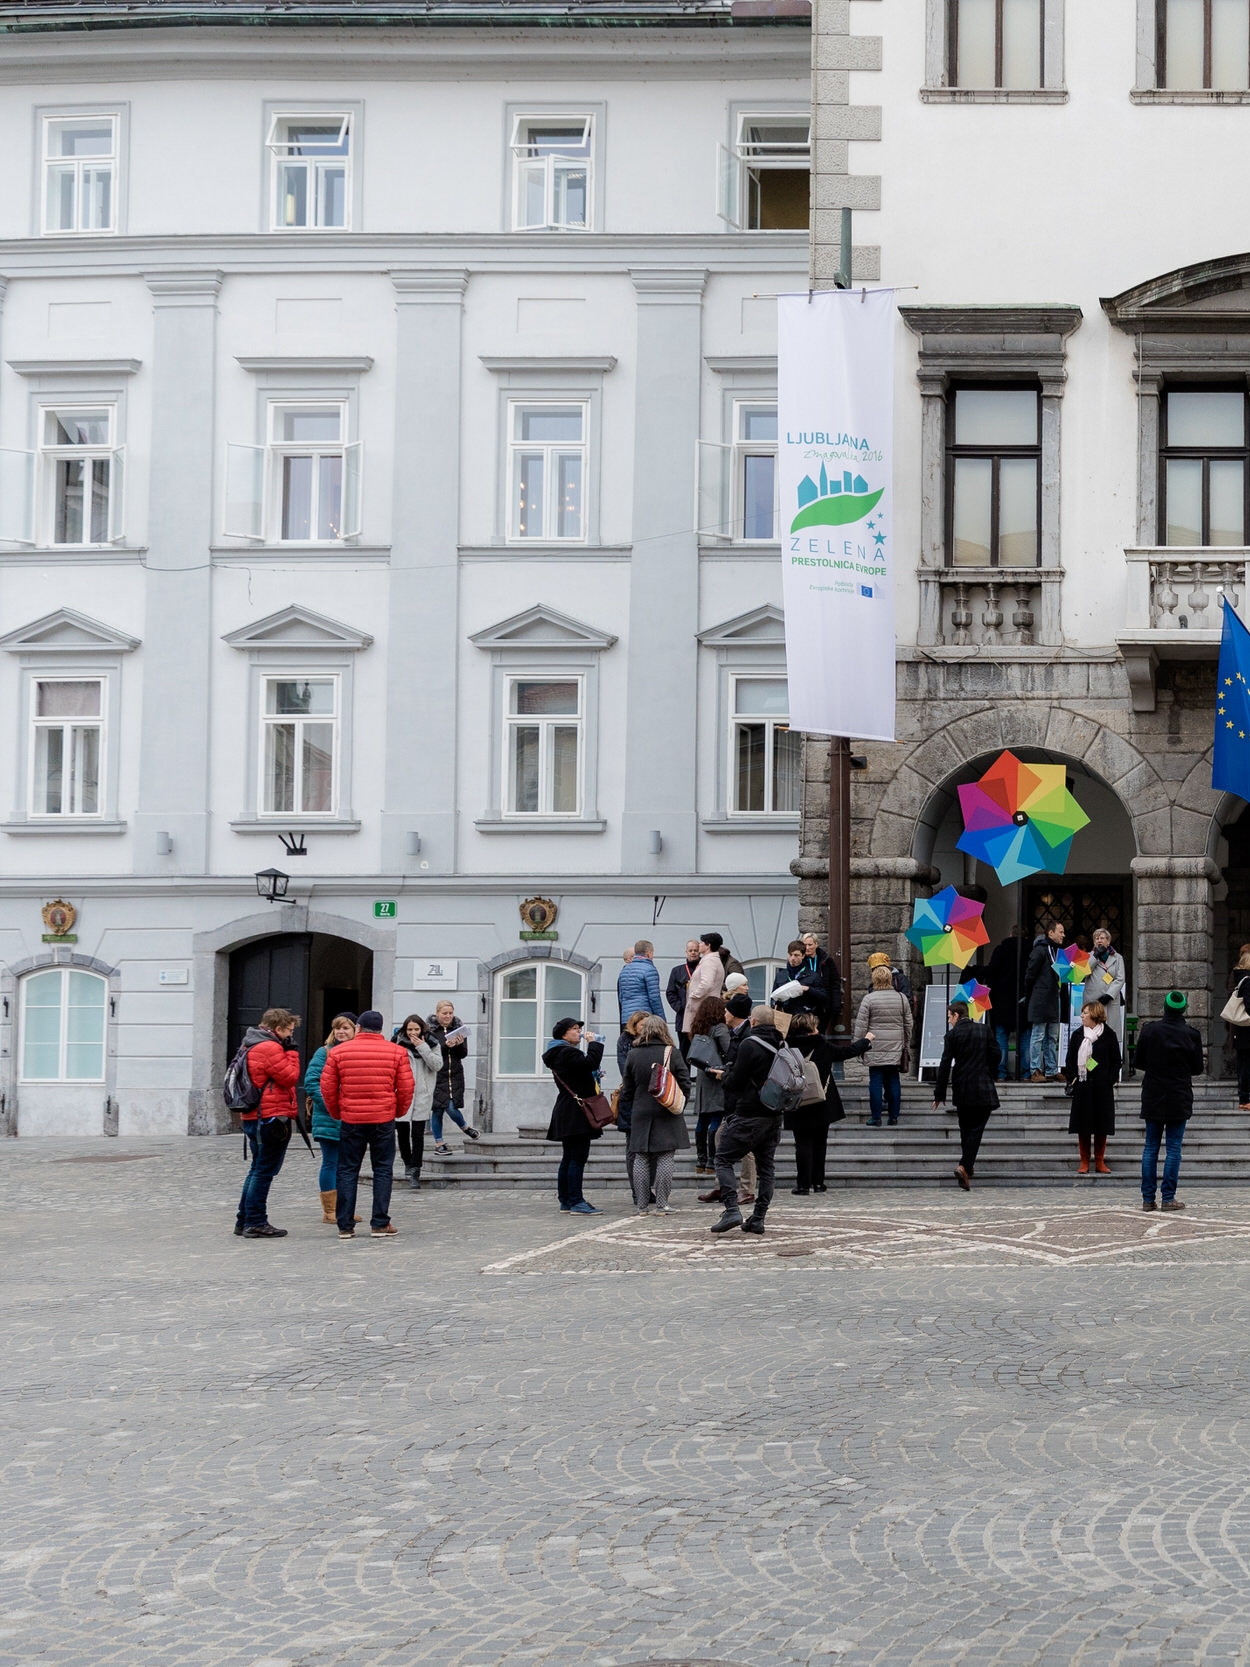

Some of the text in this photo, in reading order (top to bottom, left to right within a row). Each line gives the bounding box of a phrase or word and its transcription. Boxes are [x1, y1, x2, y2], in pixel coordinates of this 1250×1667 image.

[786, 432, 870, 451] LJUBLJANA
[862, 450, 883, 462] 2016
[790, 537, 886, 562] ZELENA
[791, 556, 887, 577] PRESTOLNICA EVROPE
[380, 903, 390, 913] 27
